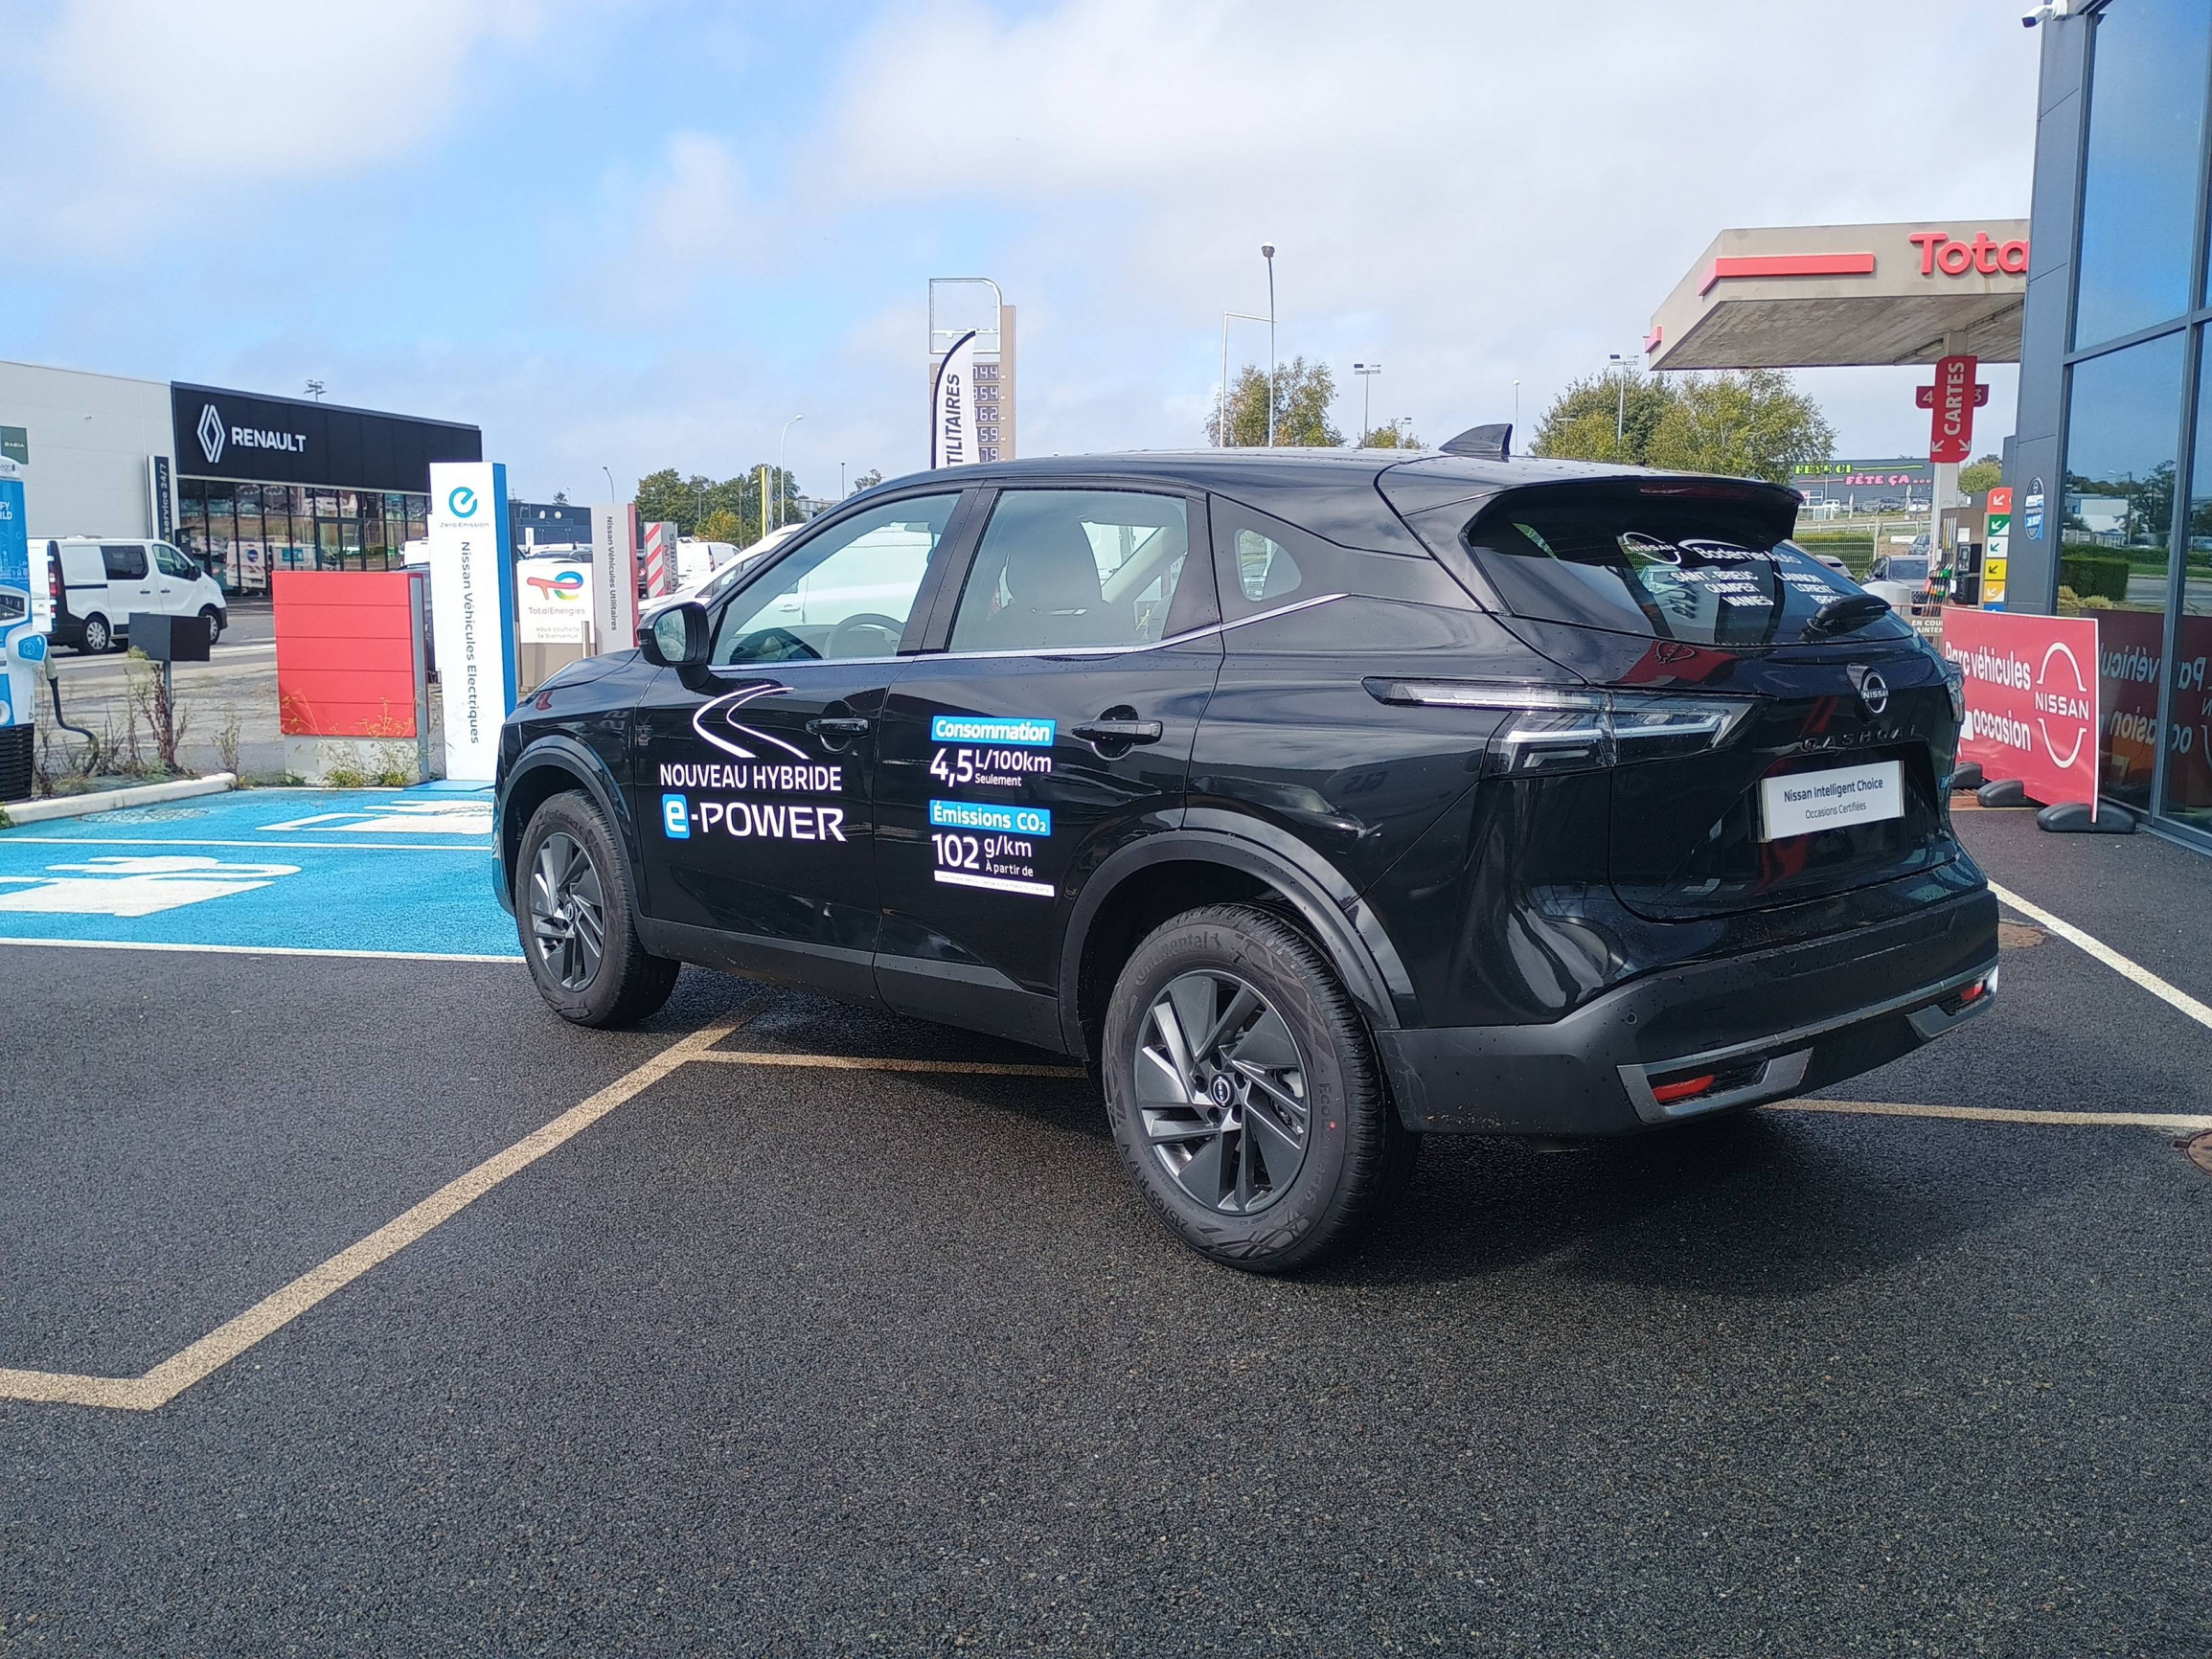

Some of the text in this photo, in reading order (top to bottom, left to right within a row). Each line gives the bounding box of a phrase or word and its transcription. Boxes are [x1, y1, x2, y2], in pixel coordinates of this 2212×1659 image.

[1922, 390, 1934, 403] 4
[1944, 362, 1965, 436] CARTES
[1973, 388, 1982, 402] 3
[975, 407, 998, 421] 62
[232, 426, 307, 453] RENAULT
[159, 463, 169, 489] 24/7
[1845, 473, 1883, 486] FÊTE
[161, 491, 171, 534] service
[1627, 544, 1676, 554] NISSAN
[607, 546, 616, 587] Véhicules
[1704, 582, 1760, 594] QUIMPER
[1722, 595, 1774, 607] VANNES
[528, 606, 585, 616] TotalEnergies
[609, 587, 618, 631] Utilitaires
[461, 541, 479, 743] Nissan Véhicules Electriques
[1972, 646, 2031, 691] véhicules
[1861, 690, 1888, 699] NISSAN
[2035, 691, 2089, 720] NISSAN
[936, 719, 1051, 741] Consommation
[1973, 709, 2032, 752] occasion
[659, 763, 842, 791] NOUVEAU HYBRIDE
[929, 748, 1052, 787] 4,5 L/100km
[974, 773, 1022, 786] Seulement
[1784, 777, 1883, 803] Nissan Intelligent Choice
[665, 800, 849, 842] e-POWER
[933, 801, 1012, 830] Émissions
[1805, 801, 1867, 820] Occasions Certifiées
[931, 833, 1033, 870] 102 g/km
[986, 858, 1034, 877] À partir de
